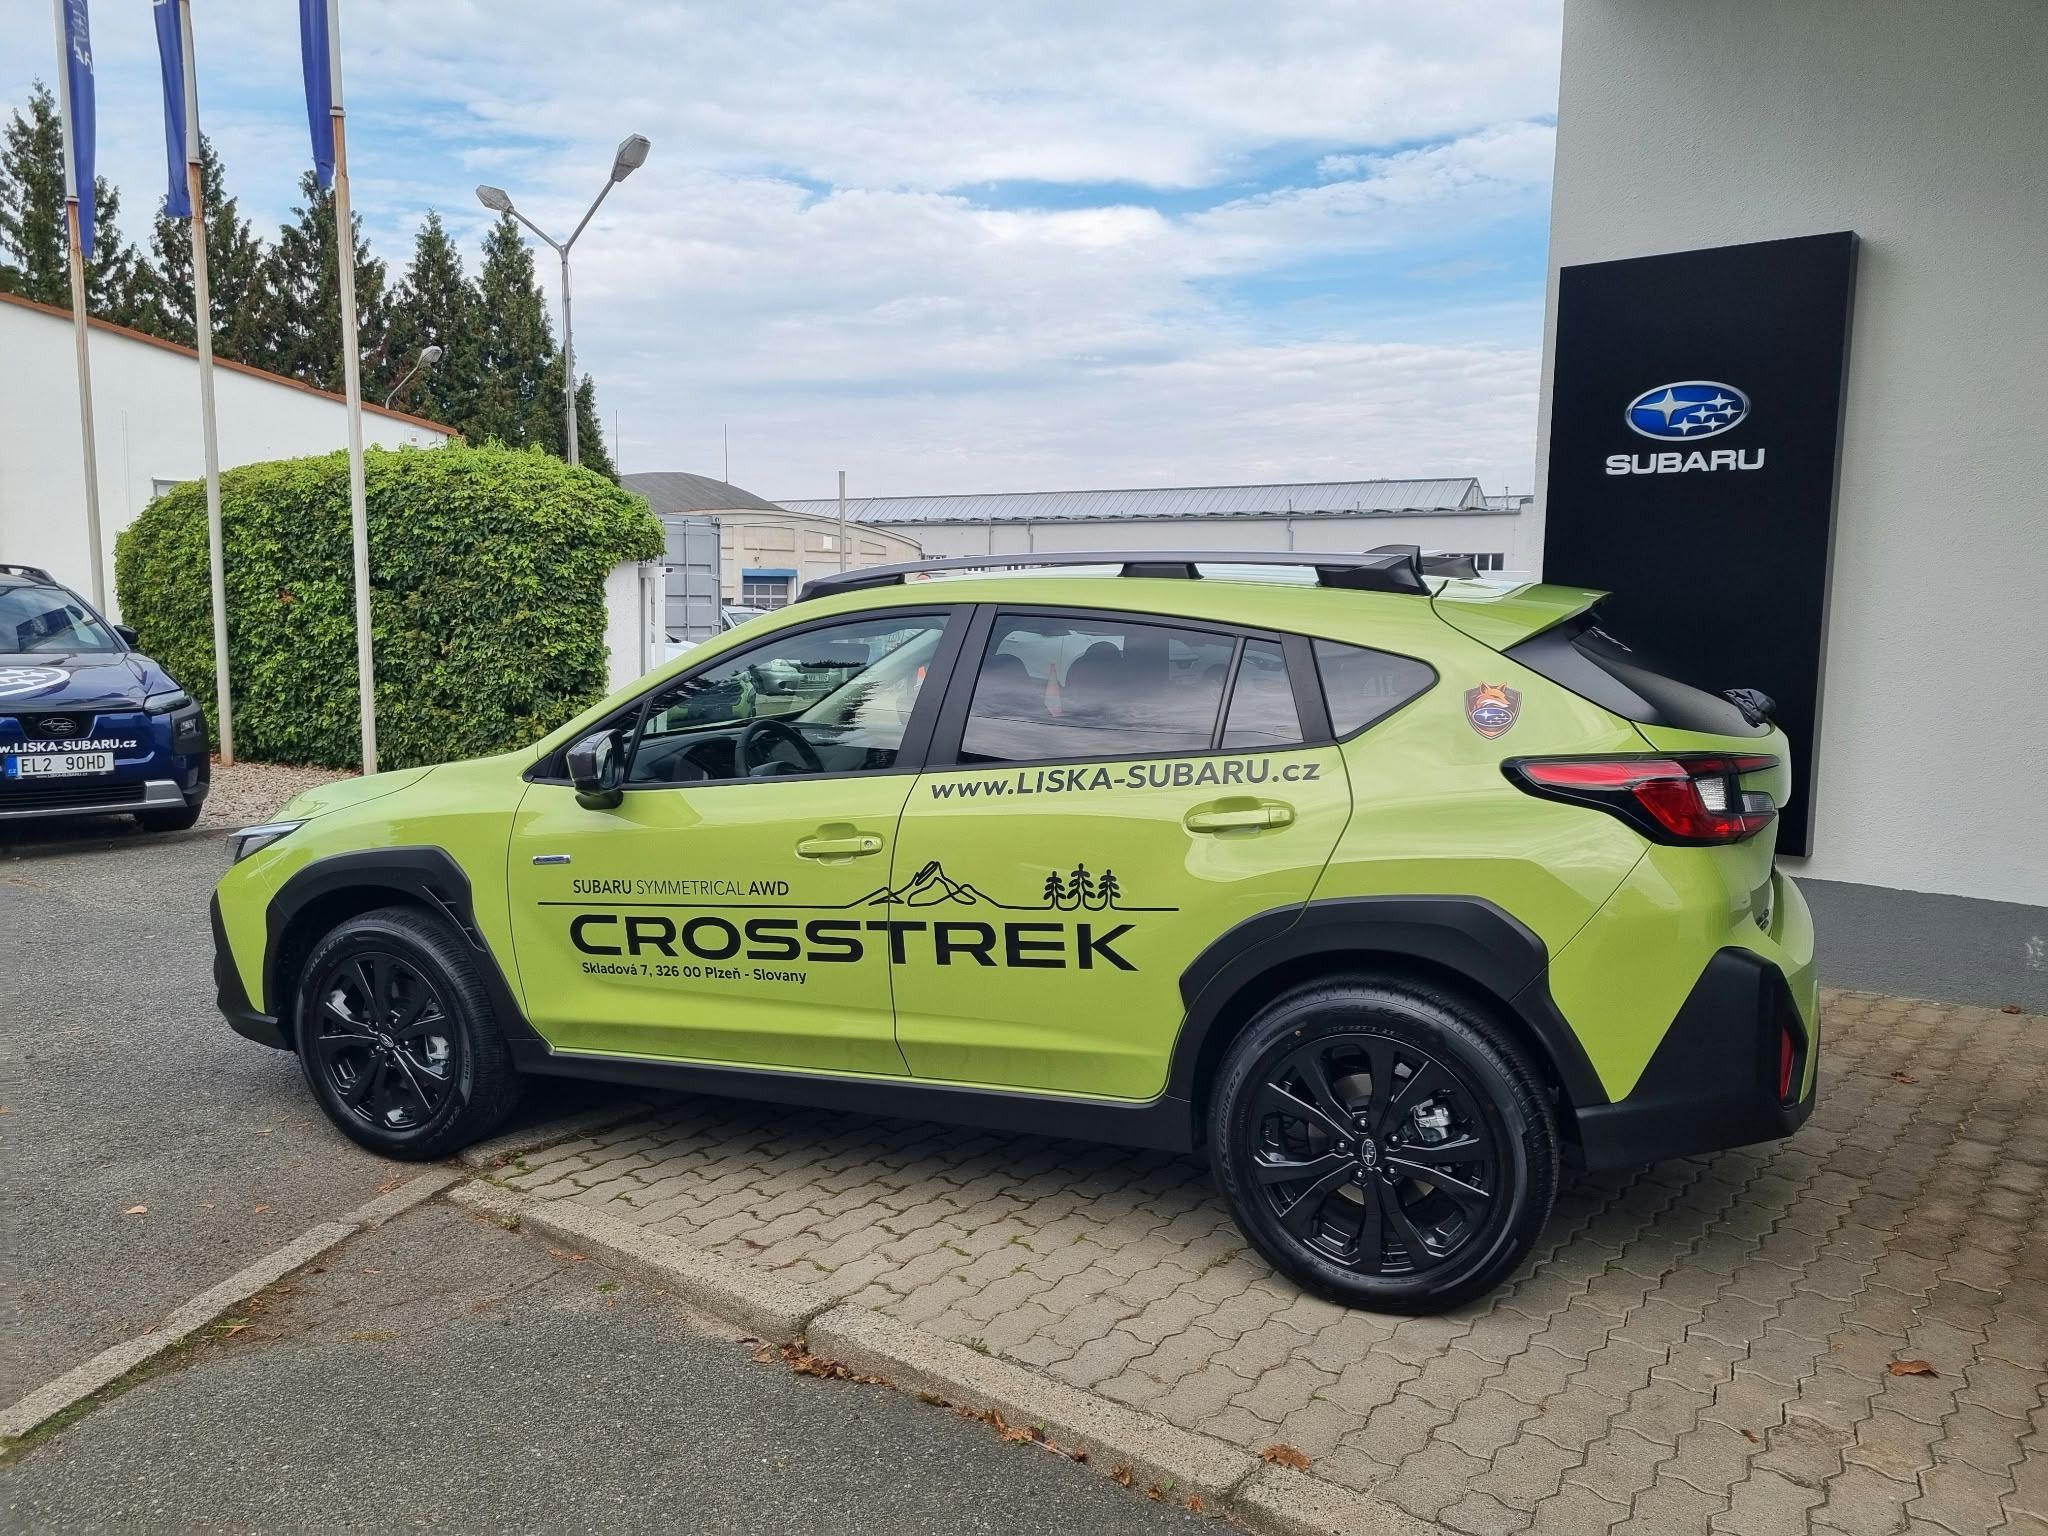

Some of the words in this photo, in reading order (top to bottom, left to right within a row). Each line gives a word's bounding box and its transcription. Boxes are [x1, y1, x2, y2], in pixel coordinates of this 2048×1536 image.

[1605, 448, 1766, 476] SUBARU
[21, 757, 52, 773] EL2
[65, 754, 106, 771] 90HD
[931, 758, 1321, 800] www.LISKA-SUBARU.cz
[573, 879, 632, 895] SUBARU
[636, 880, 745, 897] SYMMETRICAL
[748, 881, 790, 897] AWD
[569, 913, 1140, 971] CROSSTREK
[582, 961, 638, 977] Skladová
[640, 964, 653, 979] 7,
[656, 965, 680, 978] 326
[683, 966, 701, 979] 00
[705, 966, 742, 981] Plzeň
[753, 968, 808, 985] Slovany
